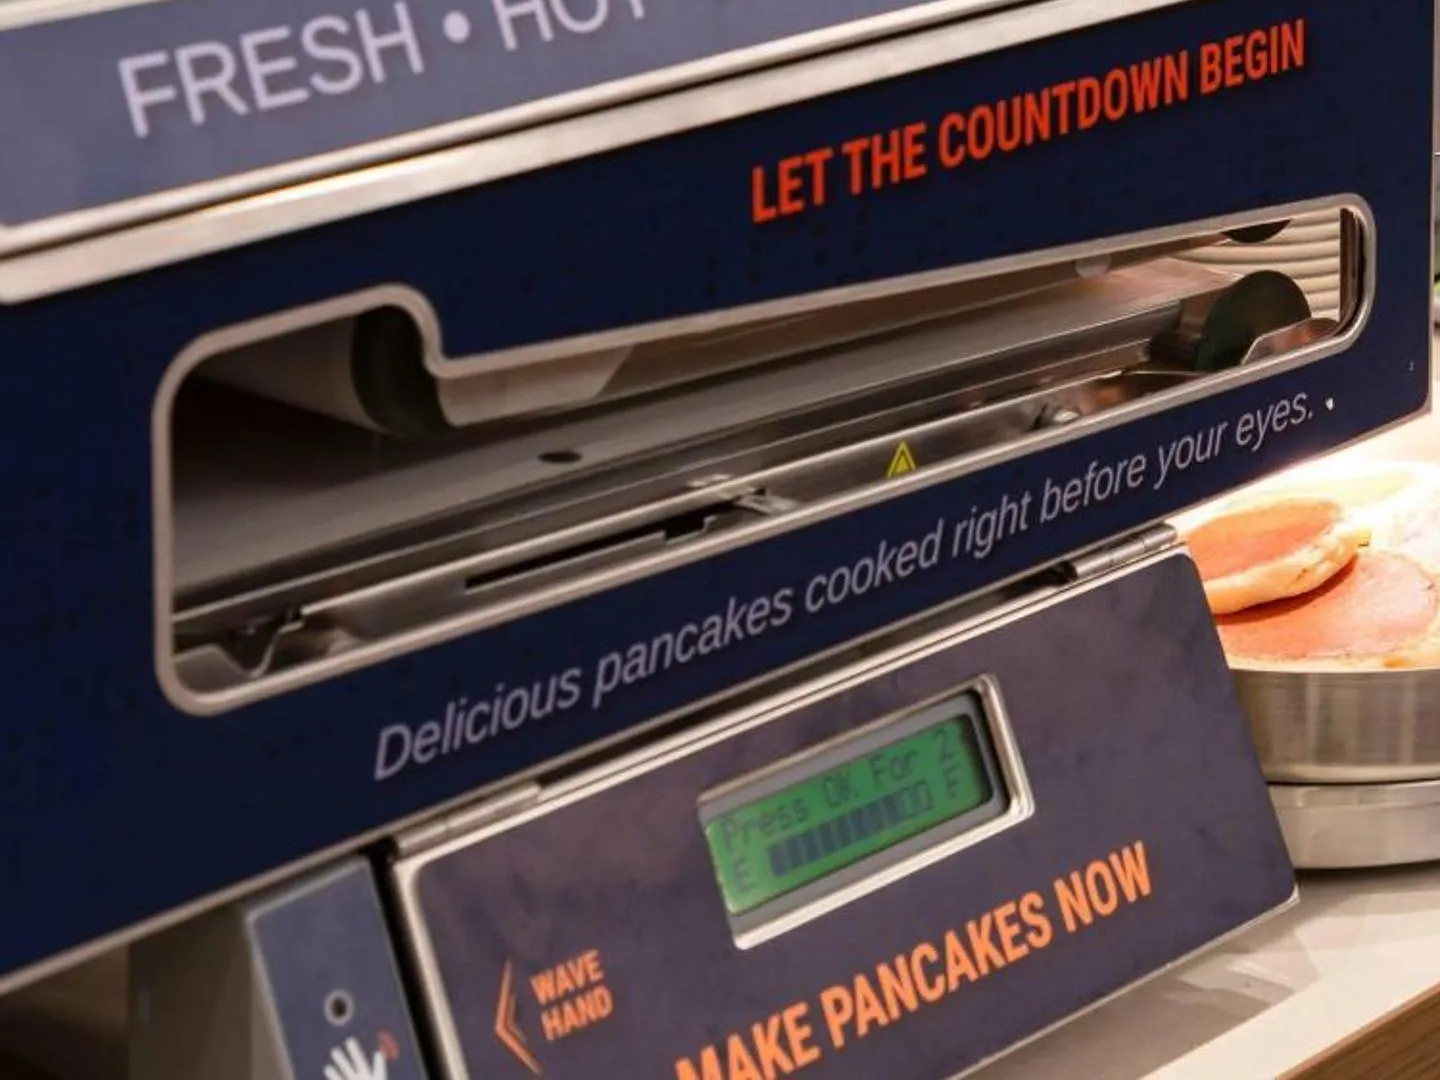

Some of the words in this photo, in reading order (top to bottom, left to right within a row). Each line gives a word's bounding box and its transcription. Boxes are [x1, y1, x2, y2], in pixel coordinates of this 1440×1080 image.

[118, 2, 423, 136] FRESH
[752, 148, 833, 222] LET
[842, 122, 927, 194] THE
[939, 50, 1188, 168] COUNTDOWN
[1200, 19, 1304, 94] BEGIN
[374, 668, 581, 780] Delicious
[592, 587, 792, 707] pancakes
[805, 519, 943, 612] cooked
[952, 489, 1032, 558] right
[1040, 454, 1147, 523] before
[1153, 420, 1228, 490] your
[1235, 392, 1315, 452] eyes.
[723, 798, 810, 851] Press
[822, 773, 858, 809] OK
[868, 749, 918, 786] For
[530, 949, 604, 1006] WAVE
[819, 891, 1053, 1048] PANCAKES
[1053, 840, 1151, 933] NOW
[541, 985, 613, 1041] HAND
